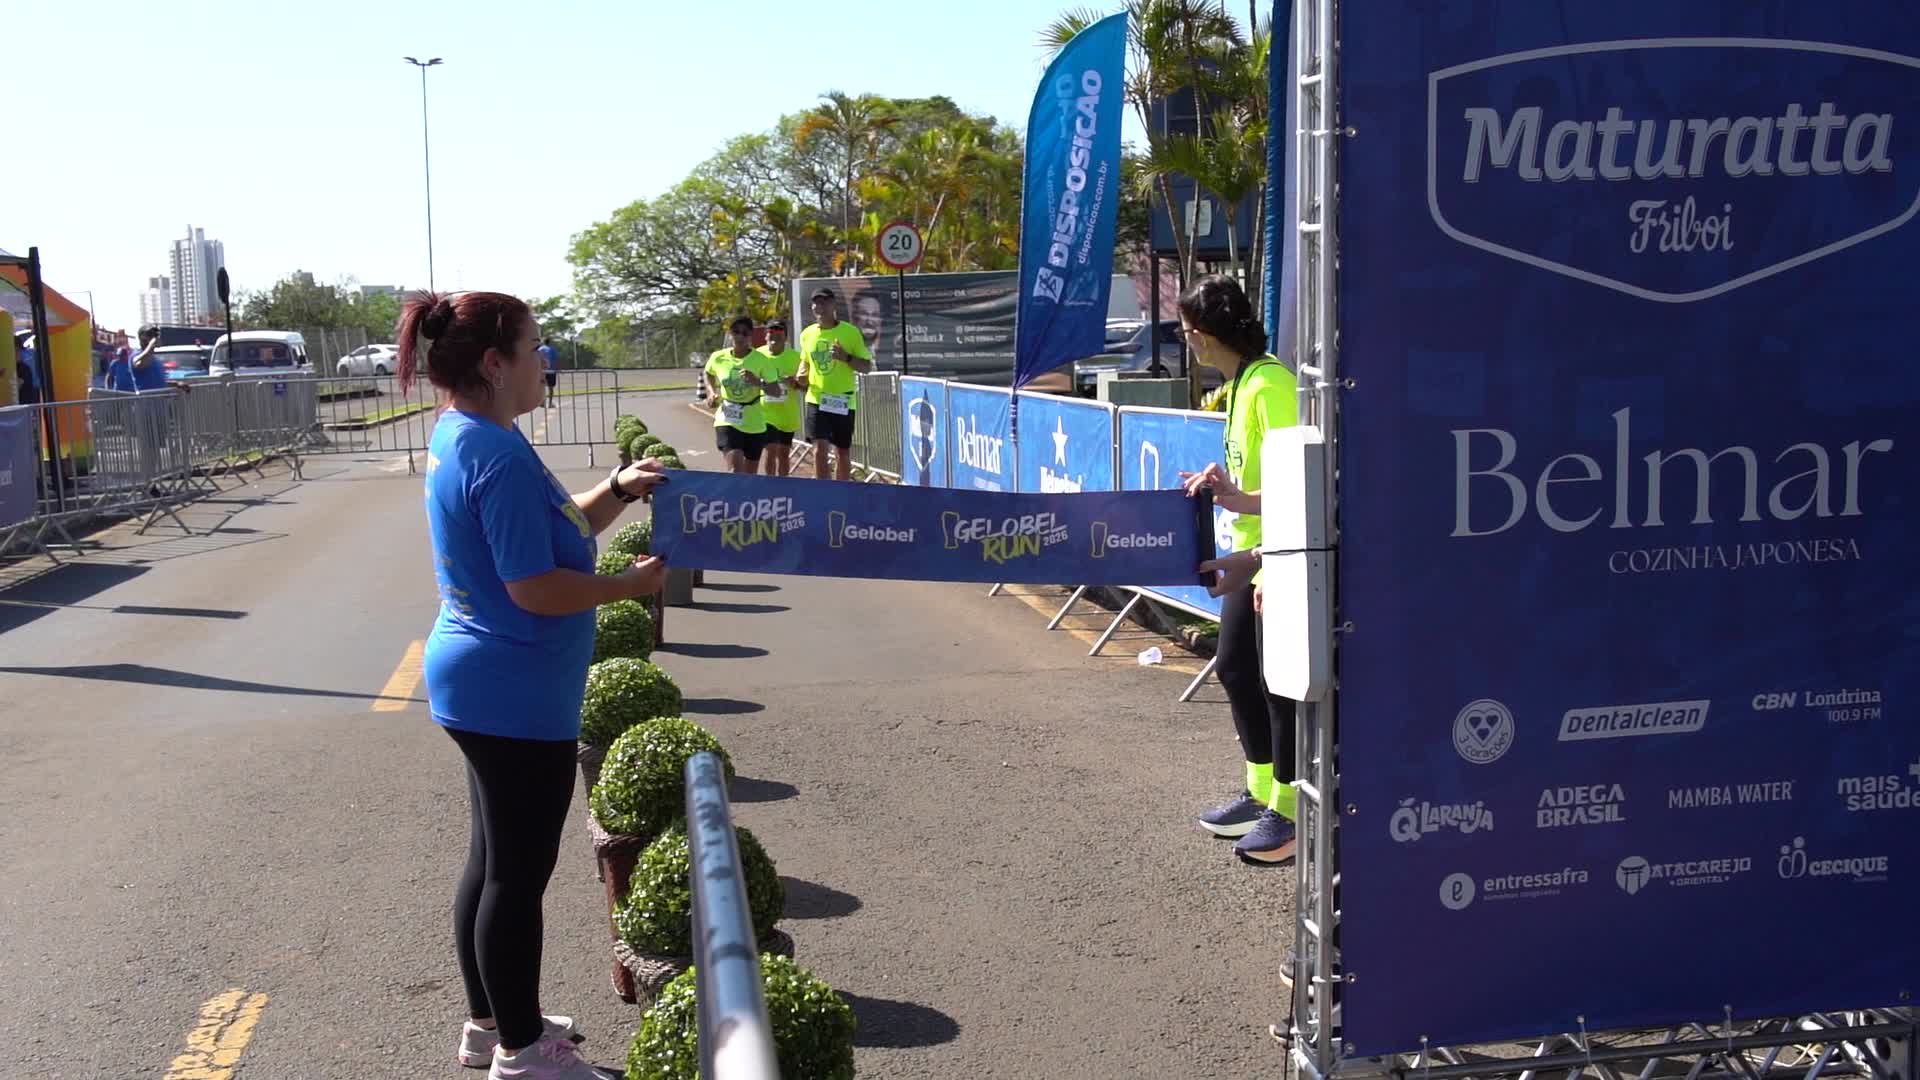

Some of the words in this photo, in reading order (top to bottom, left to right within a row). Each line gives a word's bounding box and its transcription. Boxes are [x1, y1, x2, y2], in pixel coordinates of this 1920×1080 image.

[1463, 102, 1894, 183] Maturatta
[1077, 160, 1108, 264] disposicao.com.br
[1628, 196, 1734, 254] Friboi
[889, 234, 912, 250] 20
[957, 414, 1002, 475] Belmar
[1449, 406, 1894, 538] Belmar
[692, 497, 804, 526] GELOBEL
[720, 519, 778, 550] RUN
[781, 517, 806, 533] 2026
[845, 525, 915, 543] Gelobel
[954, 512, 1067, 542] GELOBEL
[1106, 532, 1173, 549] Gelobel
[980, 535, 1041, 564] RUN
[1043, 529, 1068, 546] 2026
[1609, 545, 1728, 574] COZINHA
[1729, 538, 1861, 570] JAPONESA
[1752, 691, 1796, 711] CBN
[1805, 688, 1881, 706] Londrina
[1567, 705, 1700, 734] Dentalclean
[1828, 709, 1859, 723] 100.9
[1863, 707, 1881, 721] FM
[1538, 784, 1625, 808] ADEGA
[1668, 787, 1732, 809] MAMBA
[1738, 781, 1793, 804] WATER
[1838, 775, 1900, 795] mais
[1536, 804, 1626, 828] BRASIL
[1484, 868, 1589, 892] entressafra
[1650, 857, 1752, 878] ATACAREJO
[1809, 856, 1889, 877] CECIQUE
